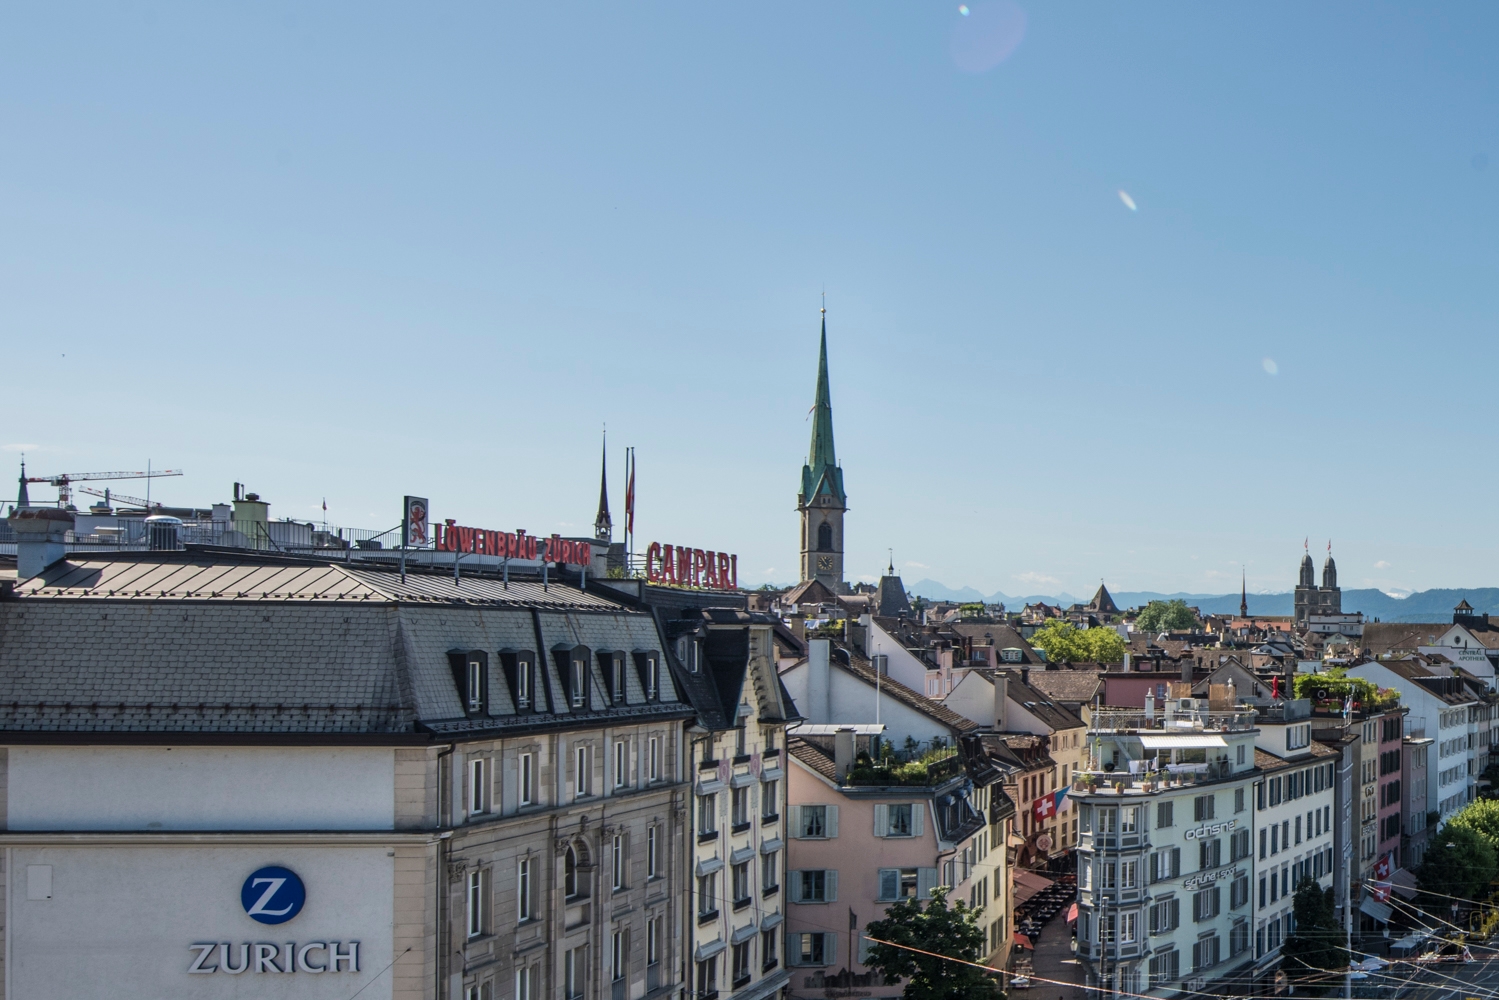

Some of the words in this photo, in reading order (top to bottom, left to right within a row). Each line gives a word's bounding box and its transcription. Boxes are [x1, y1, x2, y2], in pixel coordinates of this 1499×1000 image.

[434, 518, 537, 561] LÖWENBRÄU
[543, 533, 591, 566] ZÜRICH
[646, 541, 738, 591] CAMPARI
[187, 941, 362, 974] ZURICH
